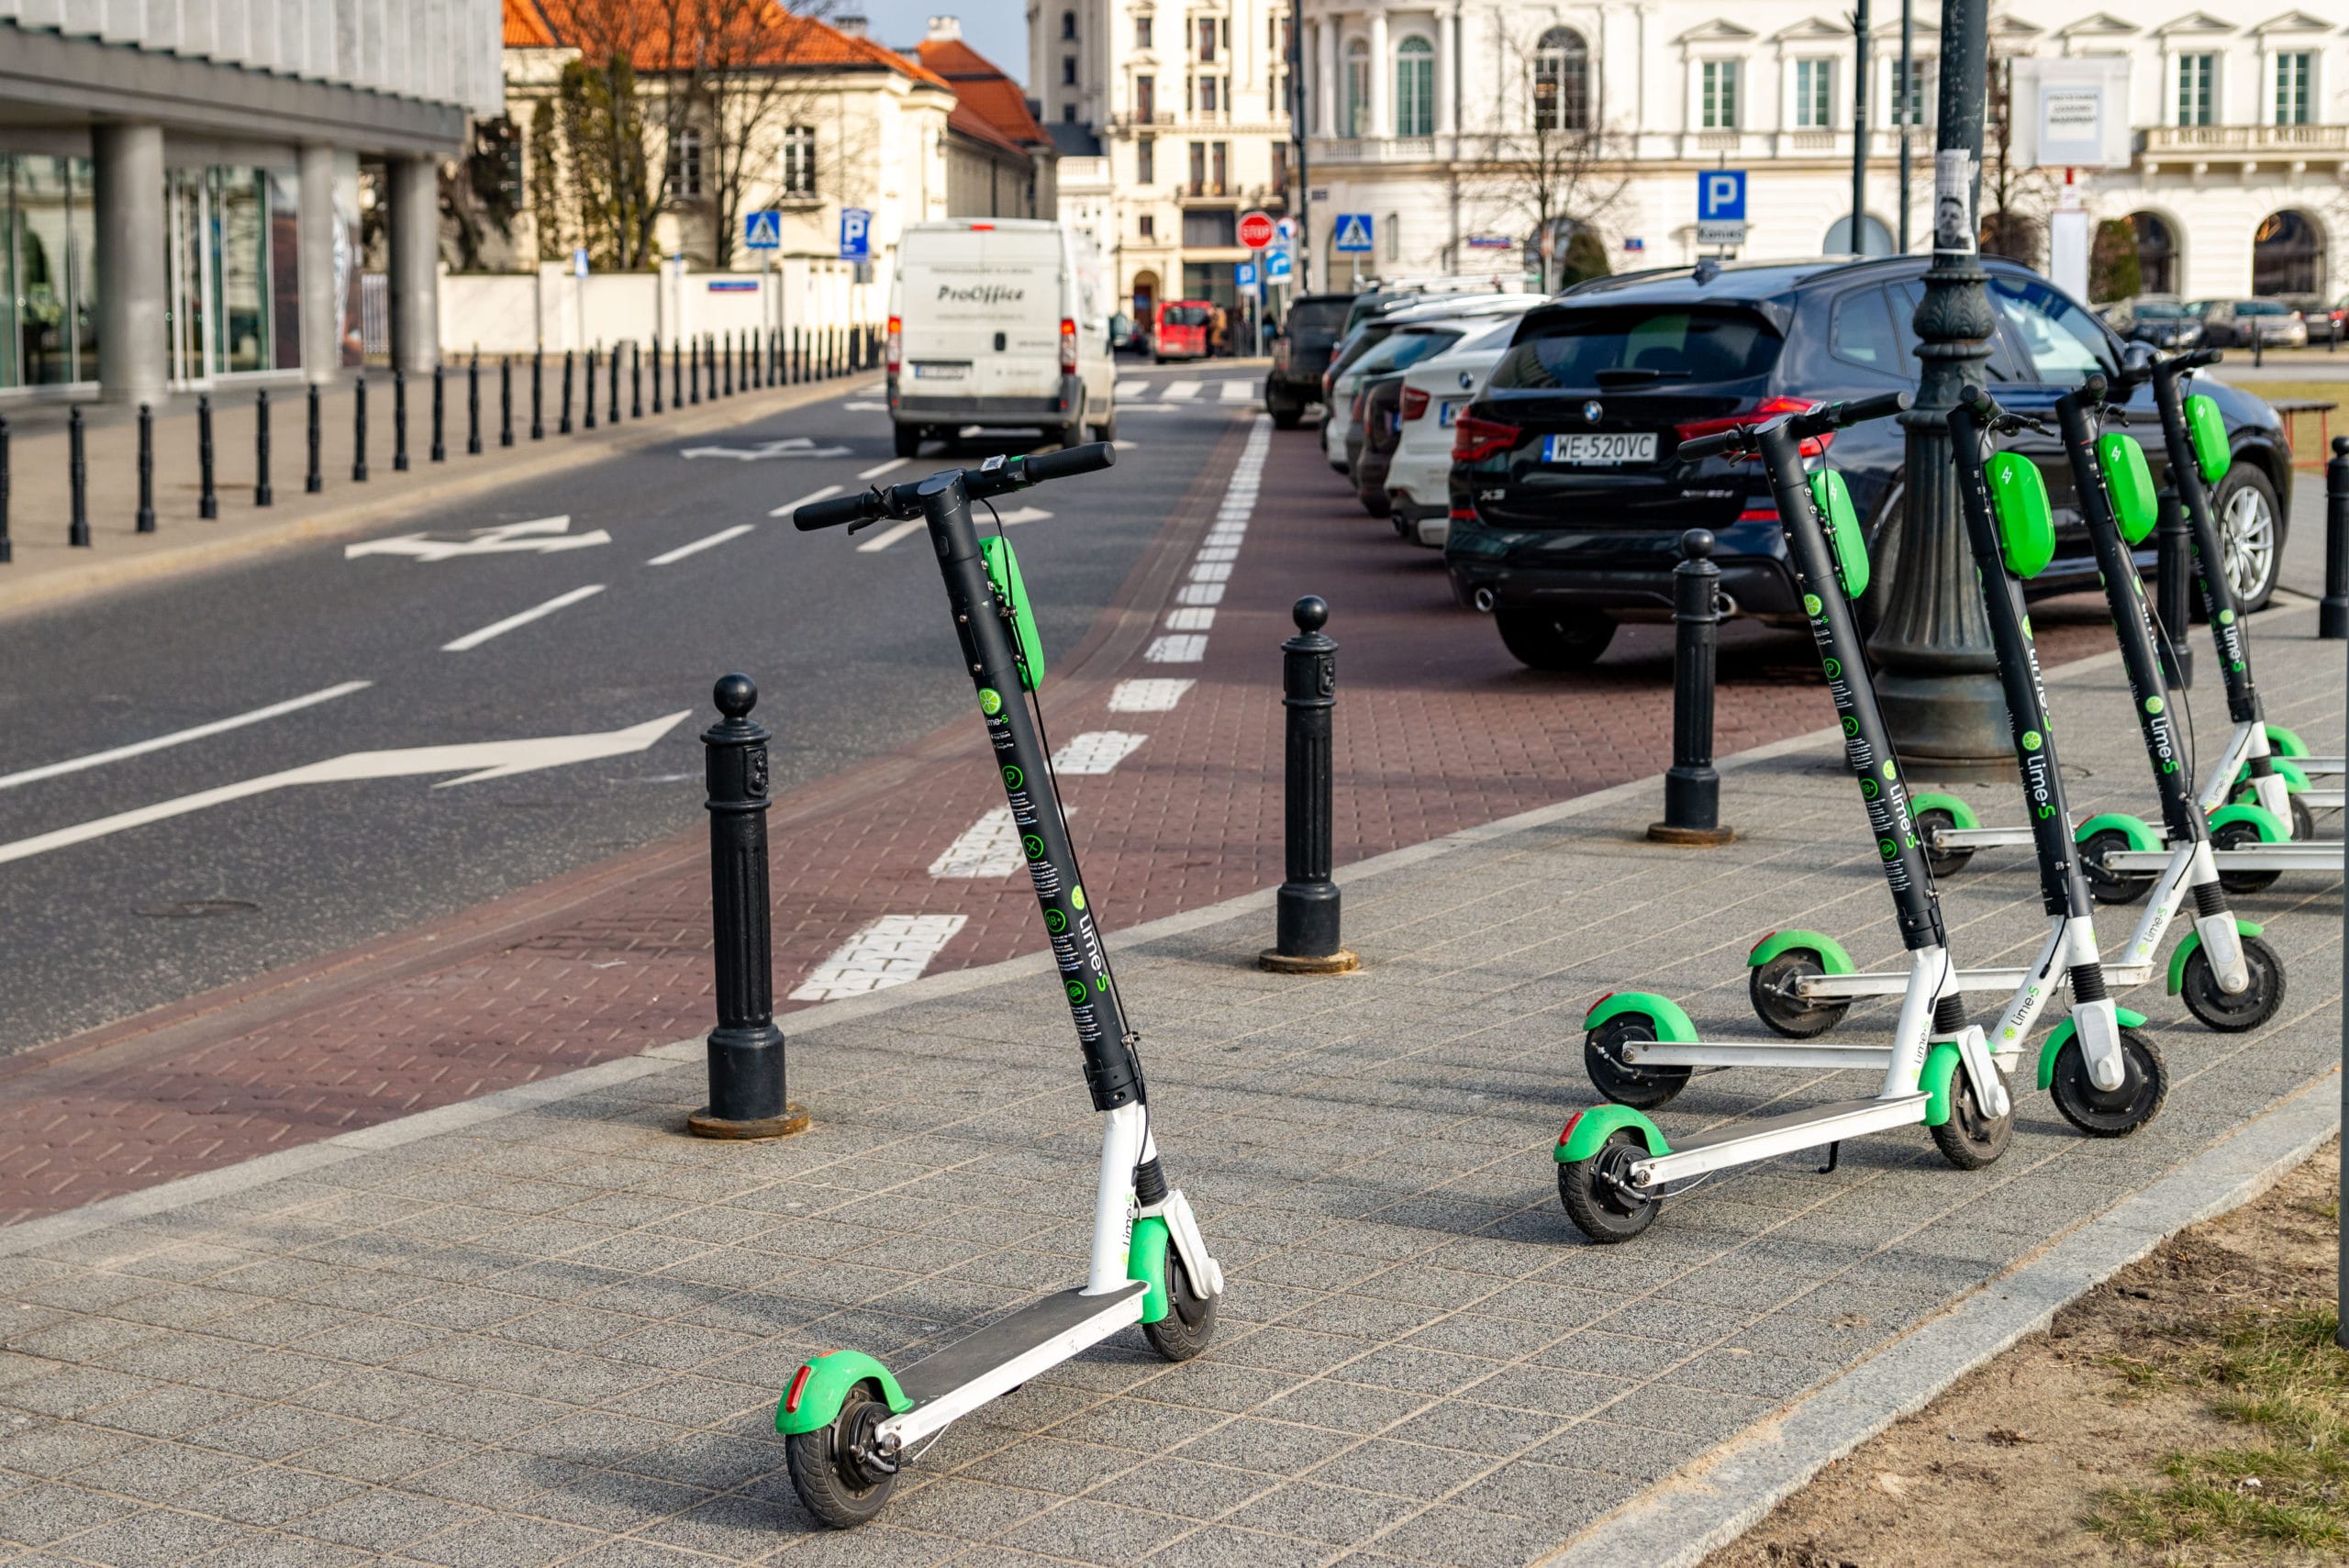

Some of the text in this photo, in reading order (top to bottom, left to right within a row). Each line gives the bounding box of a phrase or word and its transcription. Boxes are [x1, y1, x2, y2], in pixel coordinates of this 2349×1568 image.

[1709, 175, 1738, 215] P
[845, 219, 865, 243] P
[1242, 224, 1269, 239] STOP
[937, 284, 1026, 305] ProOffice
[1556, 435, 1652, 459] WE 520VC
